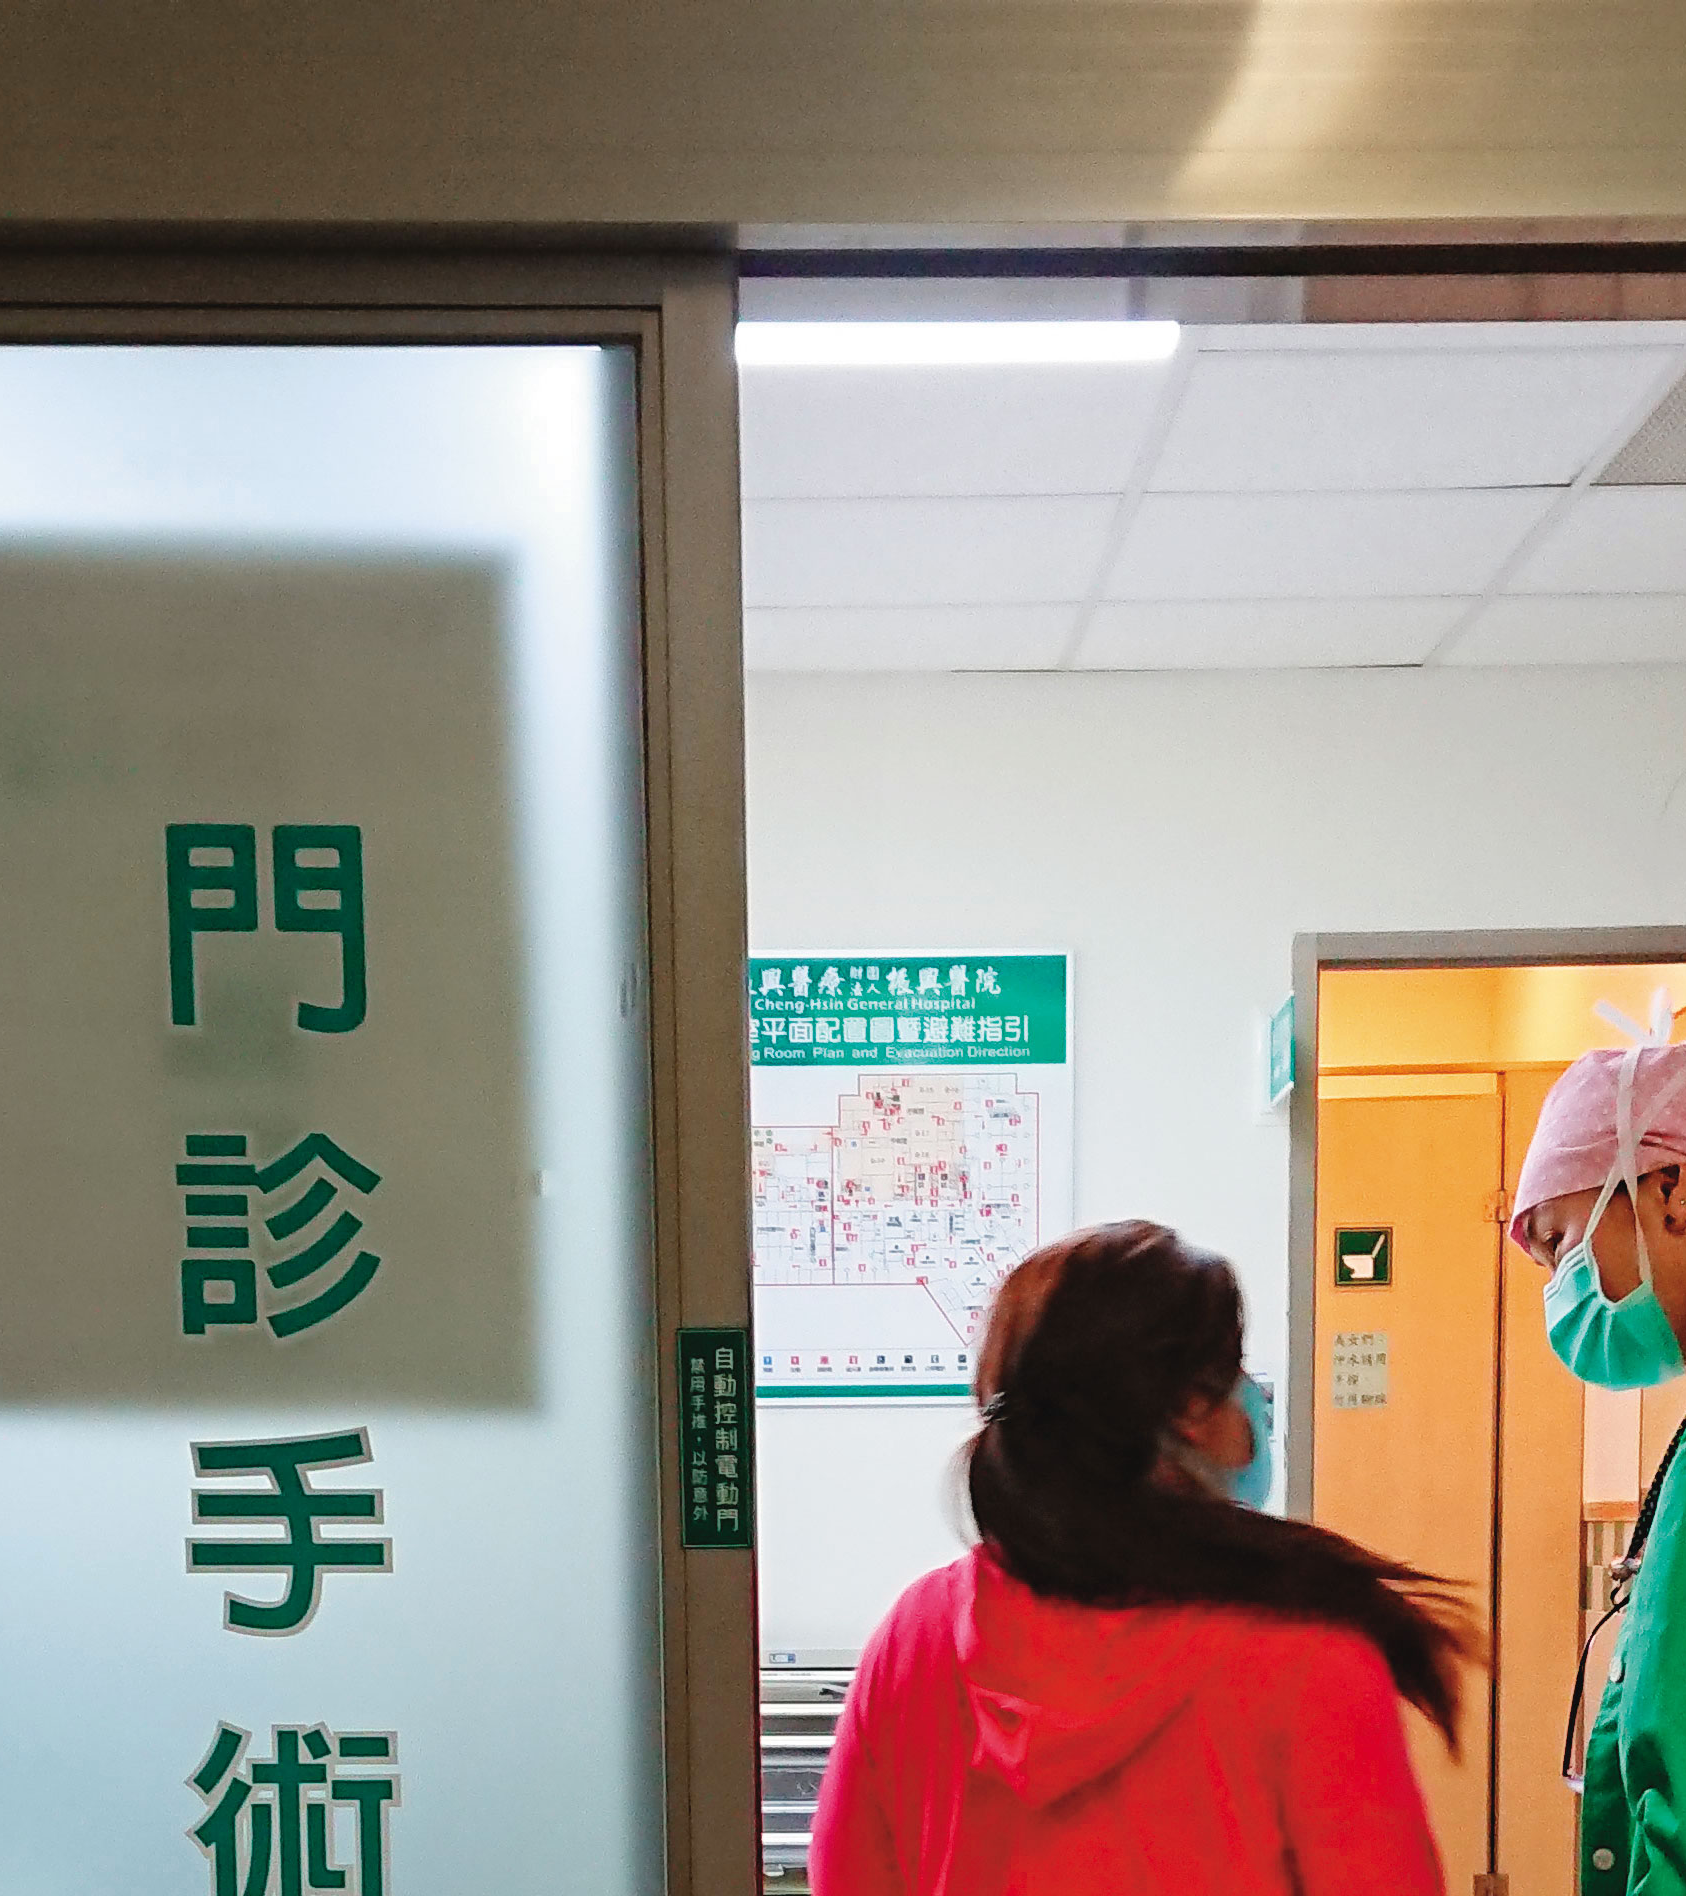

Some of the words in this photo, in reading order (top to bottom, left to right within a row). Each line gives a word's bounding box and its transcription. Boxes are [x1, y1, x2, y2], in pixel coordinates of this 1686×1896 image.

[754, 997, 844, 1014] Cheng-Hsin
[846, 997, 909, 1011] General
[911, 995, 976, 1013] Hospital
[763, 1047, 806, 1059] Room
[812, 1046, 845, 1059] Plan
[851, 1047, 878, 1059] and
[885, 1046, 964, 1059] Evacuation
[967, 1045, 1031, 1058] Direction
[713, 1347, 739, 1532] 自動控制電動門
